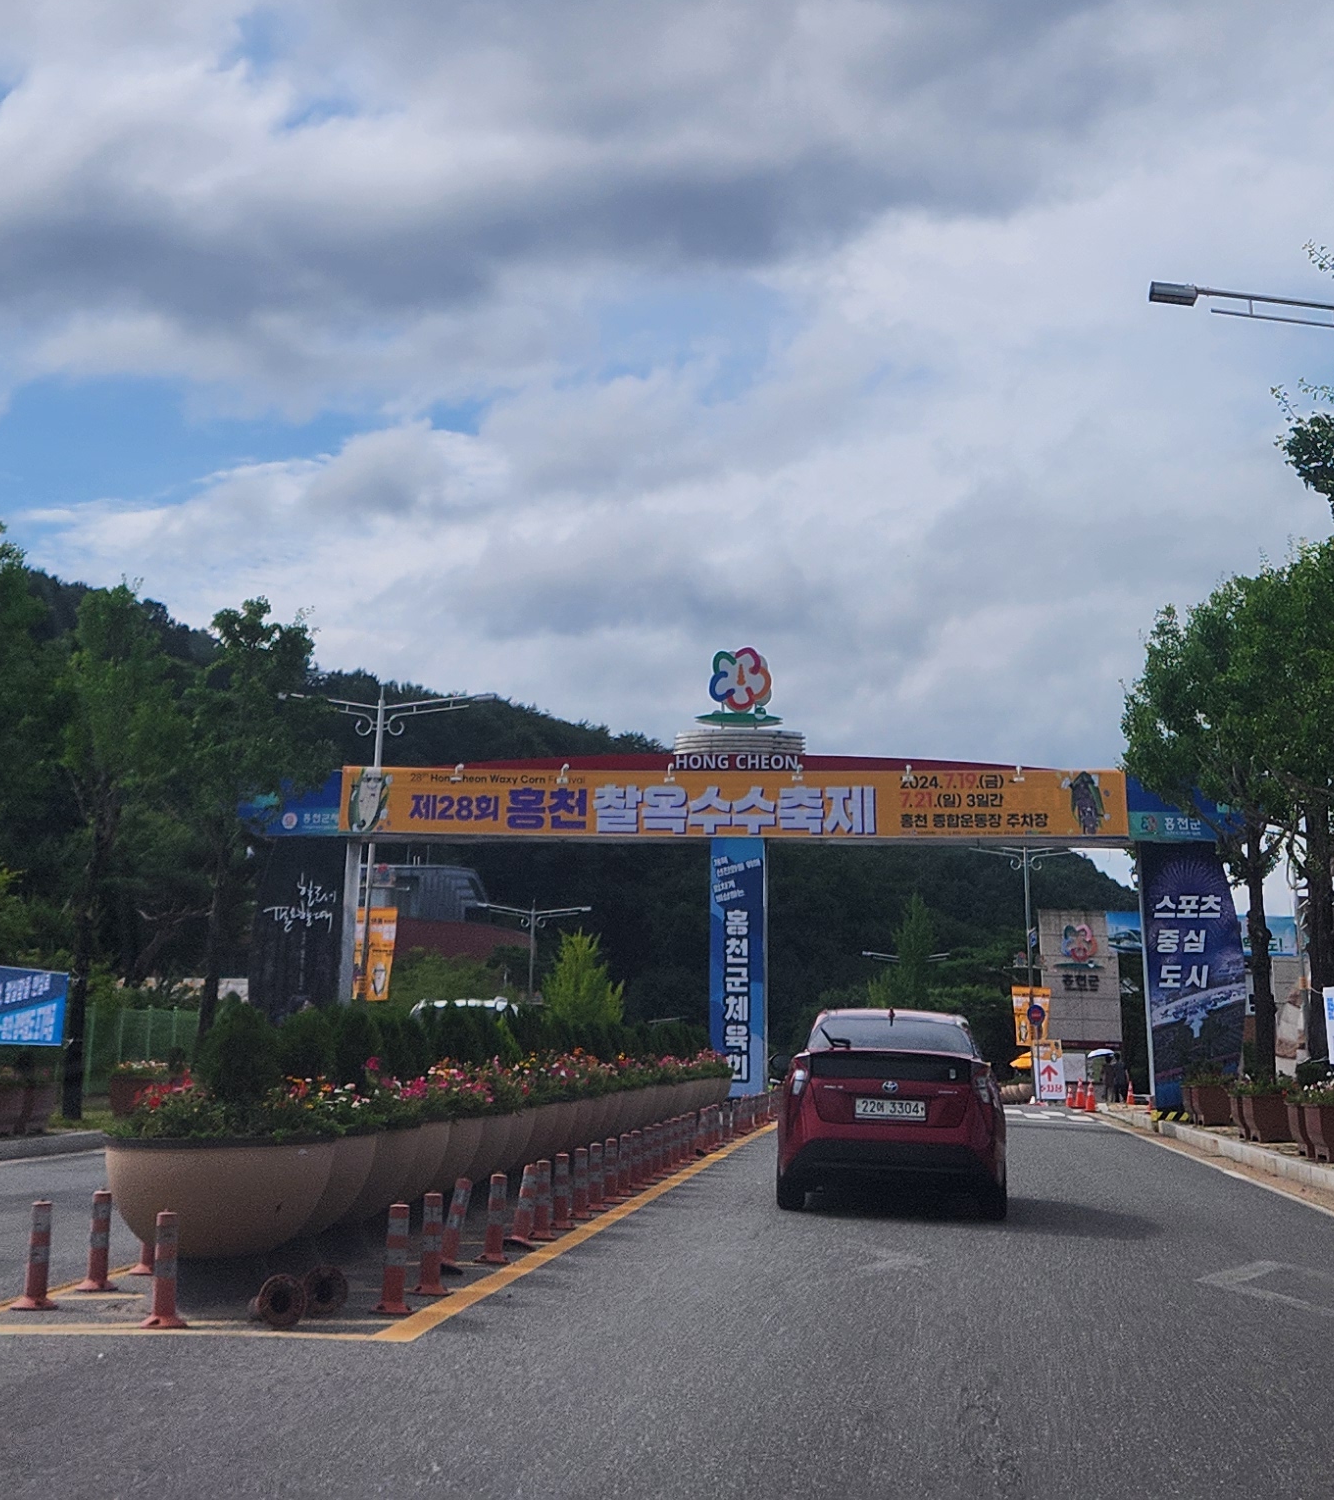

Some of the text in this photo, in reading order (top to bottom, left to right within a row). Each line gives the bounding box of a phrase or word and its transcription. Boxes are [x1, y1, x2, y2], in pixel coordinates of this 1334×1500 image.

[675, 754, 798, 770] HONG CHEON
[490, 774, 518, 786] Waxy
[520, 773, 546, 785] Corn
[899, 792, 1004, 808] 7.21.(일) 3일간
[409, 783, 877, 835] 제28회 홍천 찰옥수수축제
[900, 813, 1048, 829] 홍천 종합운동장 주차장
[1164, 816, 1201, 831] 홍천군
[1153, 894, 1222, 919] 스포츠
[1156, 929, 1207, 954] 중심
[1158, 964, 1209, 989] 도시
[724, 909, 750, 1081] 홍천군체육회
[889, 1101, 920, 1115] 3304
